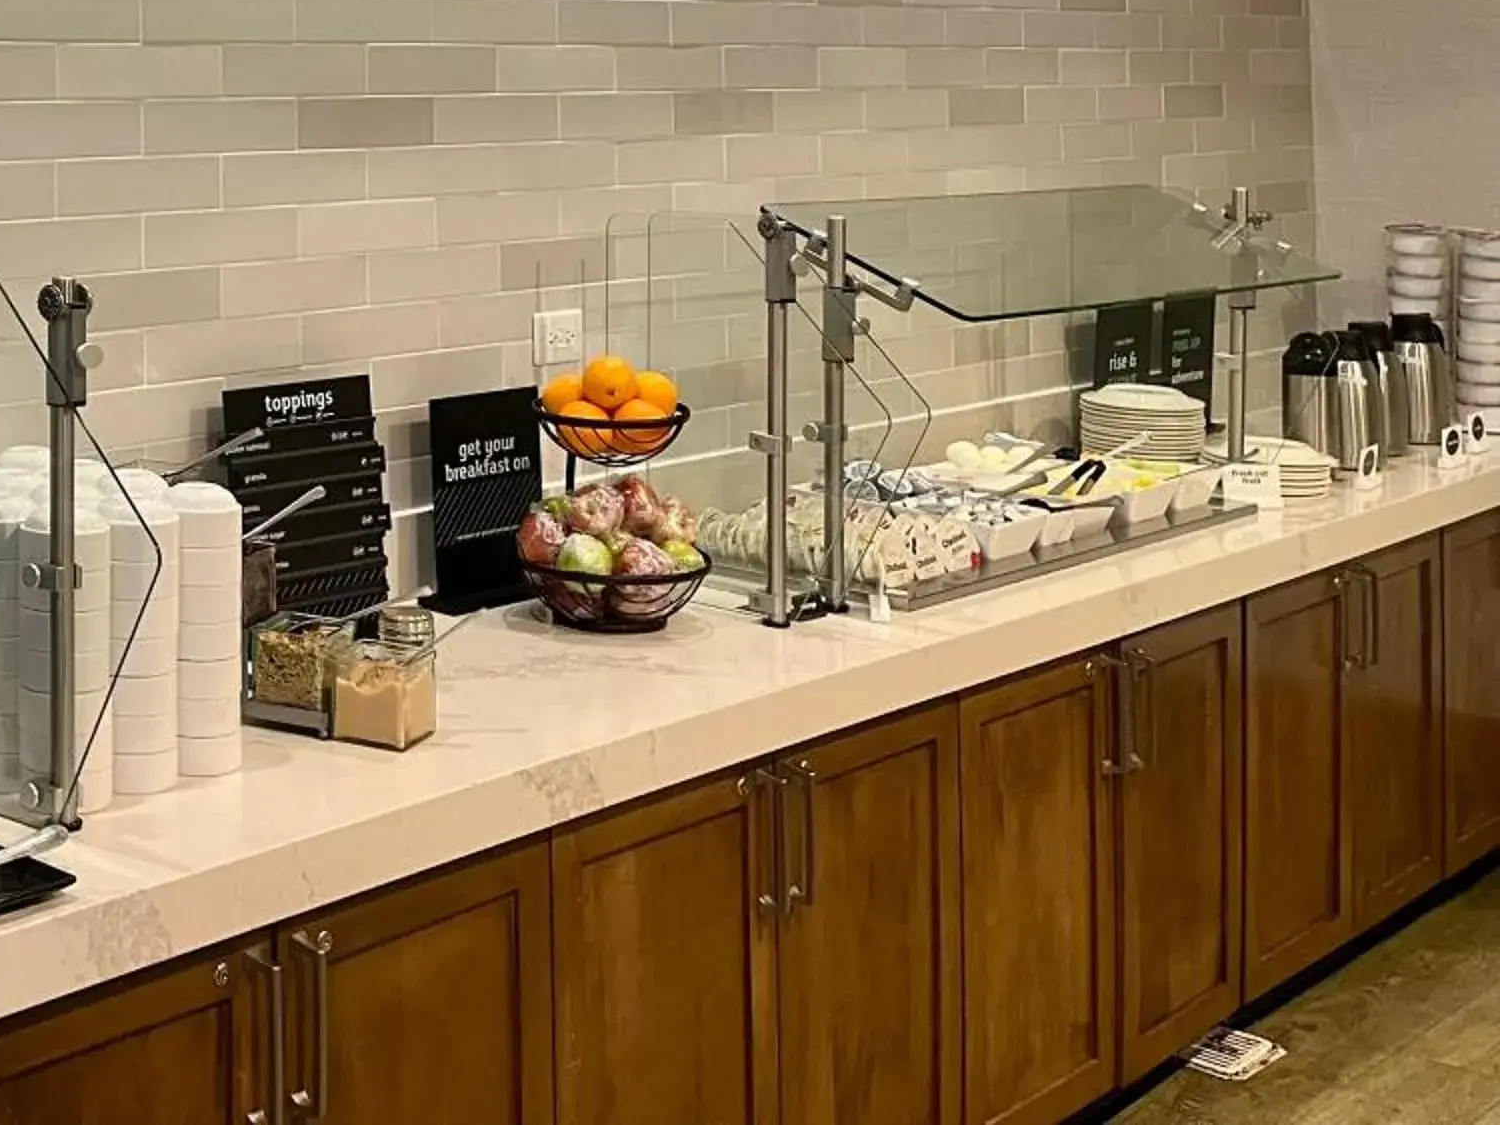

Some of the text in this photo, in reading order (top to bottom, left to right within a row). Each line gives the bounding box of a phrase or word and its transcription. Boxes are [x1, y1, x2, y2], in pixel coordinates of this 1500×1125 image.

[1109, 352, 1127, 371] rise
[265, 390, 333, 415] toppings
[459, 436, 515, 462] get your
[444, 456, 531, 482] breakfast on
